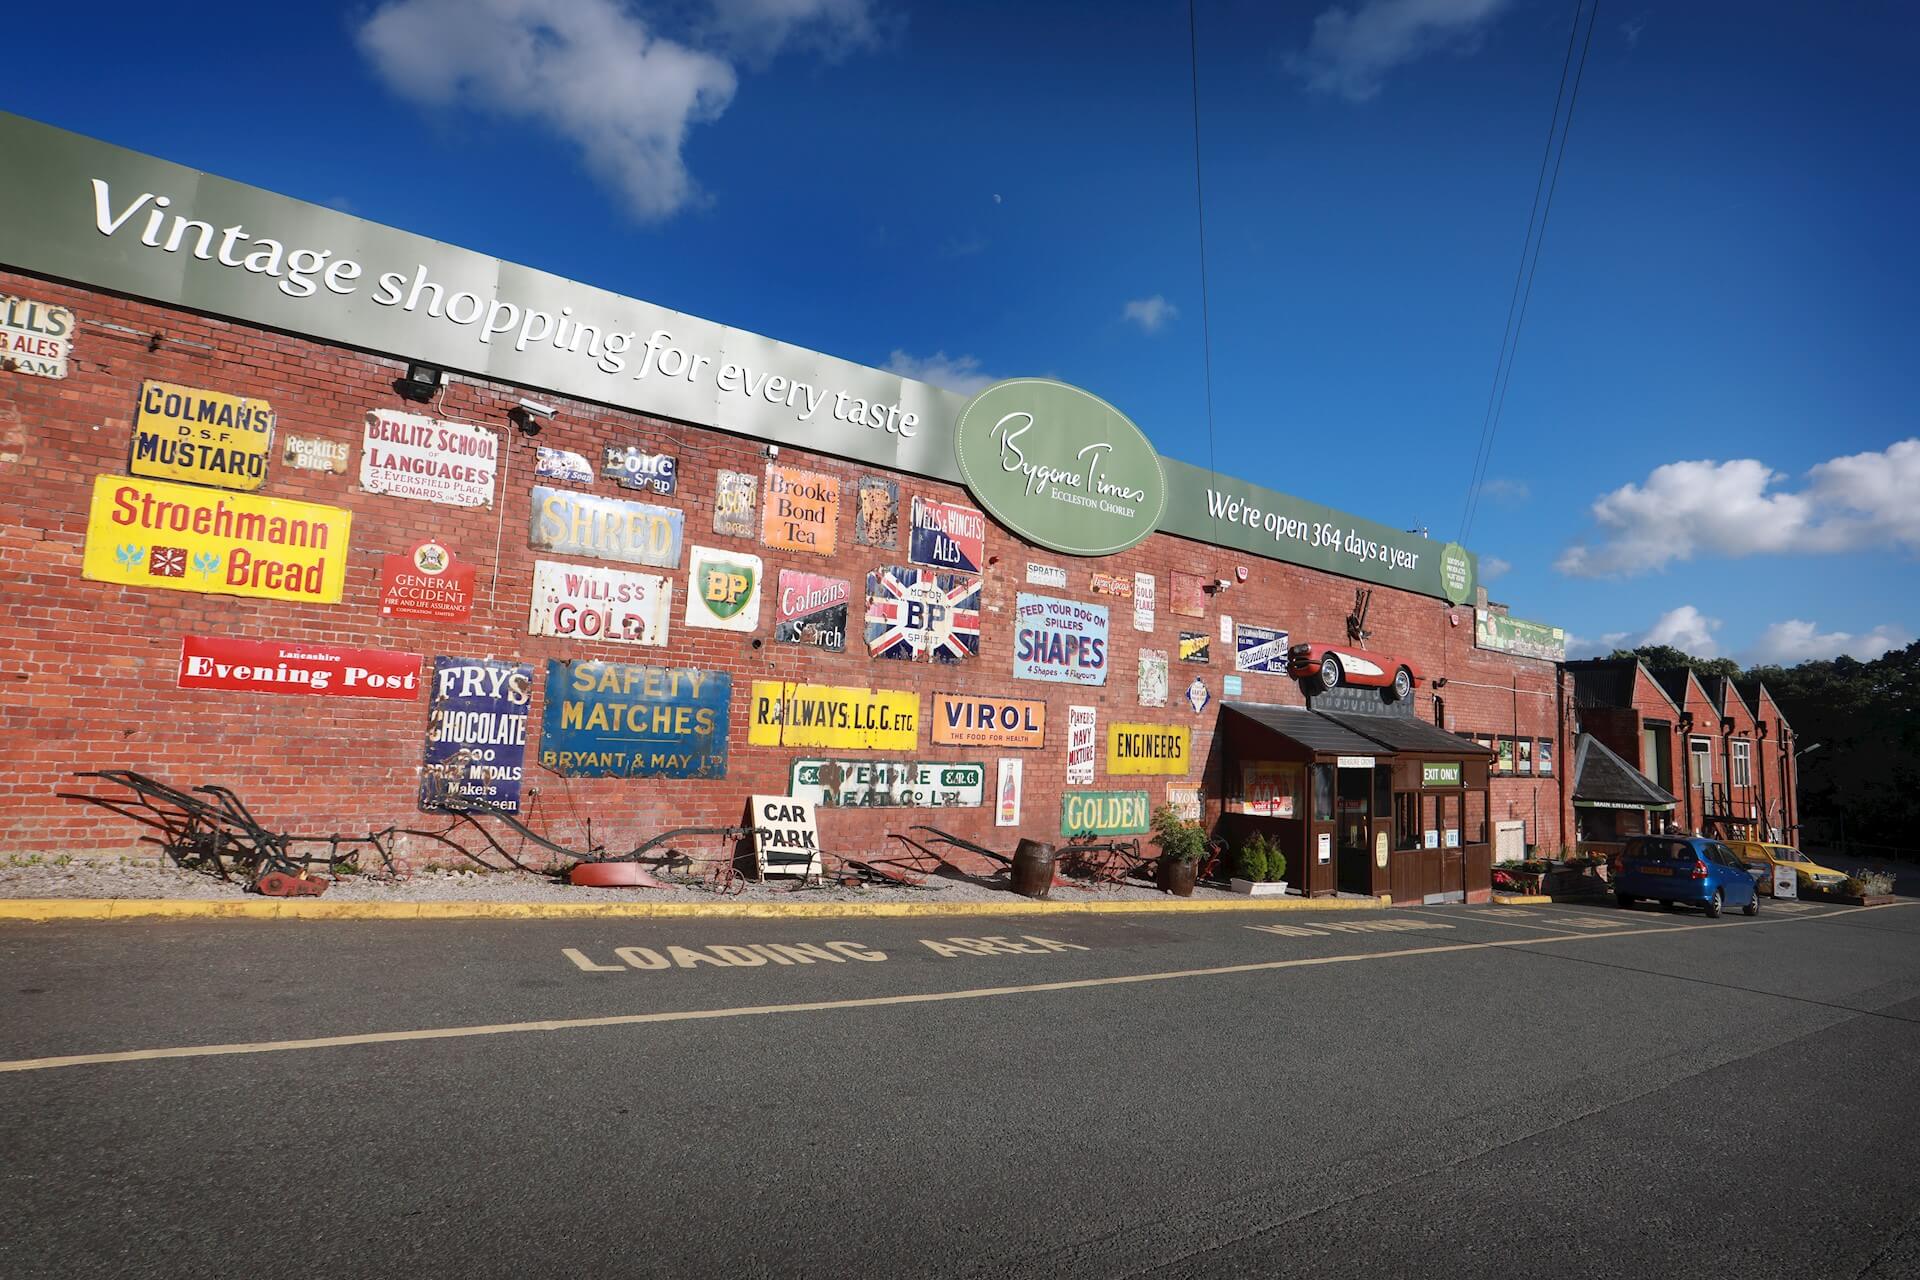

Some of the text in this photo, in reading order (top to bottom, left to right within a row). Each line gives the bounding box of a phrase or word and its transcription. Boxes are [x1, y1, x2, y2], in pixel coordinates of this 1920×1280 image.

[92, 178, 919, 437] Vintage shopping for every taste
[13, 336, 59, 358] ALES
[368, 416, 495, 460] BERLITZ SCHOOL
[137, 432, 262, 478] MUSTARD
[298, 454, 332, 470] Blue
[369, 448, 489, 485] LANGUAGES
[990, 412, 1144, 502] Bygone Times
[384, 471, 450, 489] EVERSFIELD
[388, 482, 443, 499] LEONARDS
[769, 473, 836, 504] Brooke
[778, 499, 825, 524] Bond
[1051, 488, 1136, 518] ECCLESTON CHORLEY
[112, 486, 328, 550] Stroehmann
[915, 502, 942, 531] WELLS
[784, 521, 816, 545] Tea
[1206, 489, 1419, 570] We're open 364 days a year
[933, 535, 960, 563] ALES
[226, 548, 325, 594] Bread
[395, 573, 462, 591] GENERAL
[388, 586, 466, 604] ACCIDENT
[706, 571, 749, 604] BP
[1136, 587, 1153, 599] GOLD
[430, 603, 466, 612] ASSURANCE
[905, 600, 946, 631] BP
[1020, 604, 1106, 628] FEED YOUR DOG ON
[1136, 599, 1154, 611] FLAKE
[554, 603, 645, 640] GOLD
[1045, 617, 1084, 631] SPILLERS
[791, 620, 841, 648] Srch
[908, 633, 940, 645] SPIRIT
[279, 650, 340, 661] Lancashire
[1017, 629, 1105, 669] SHAPES
[185, 656, 416, 690] Evening Post
[1027, 665, 1033, 673] 4
[1034, 666, 1058, 676] Shapes
[1064, 669, 1069, 677] 4
[1267, 659, 1281, 671] ALES
[572, 663, 706, 698] SAFETY
[429, 710, 527, 745] CHOCOLATE
[561, 701, 715, 735] MATCHES
[944, 701, 1039, 733] VIROL
[966, 733, 986, 741] FOOD
[989, 734, 1002, 742] FOR
[1005, 735, 1029, 743] HEALTH
[1073, 728, 1091, 747] NAVY
[1117, 733, 1181, 759] ENGINEERS
[543, 751, 626, 768] BRYANT
[632, 753, 644, 768] &
[651, 754, 692, 769] MAY
[1068, 745, 1093, 767] MIXTURE
[1424, 768, 1458, 780] EXIT ONLY
[448, 782, 497, 795] Makers
[764, 803, 806, 822] CAR
[1612, 802, 1645, 810] ENTRANCE
[760, 828, 816, 848] PARK
[562, 935, 1091, 972] LOADING AREA
